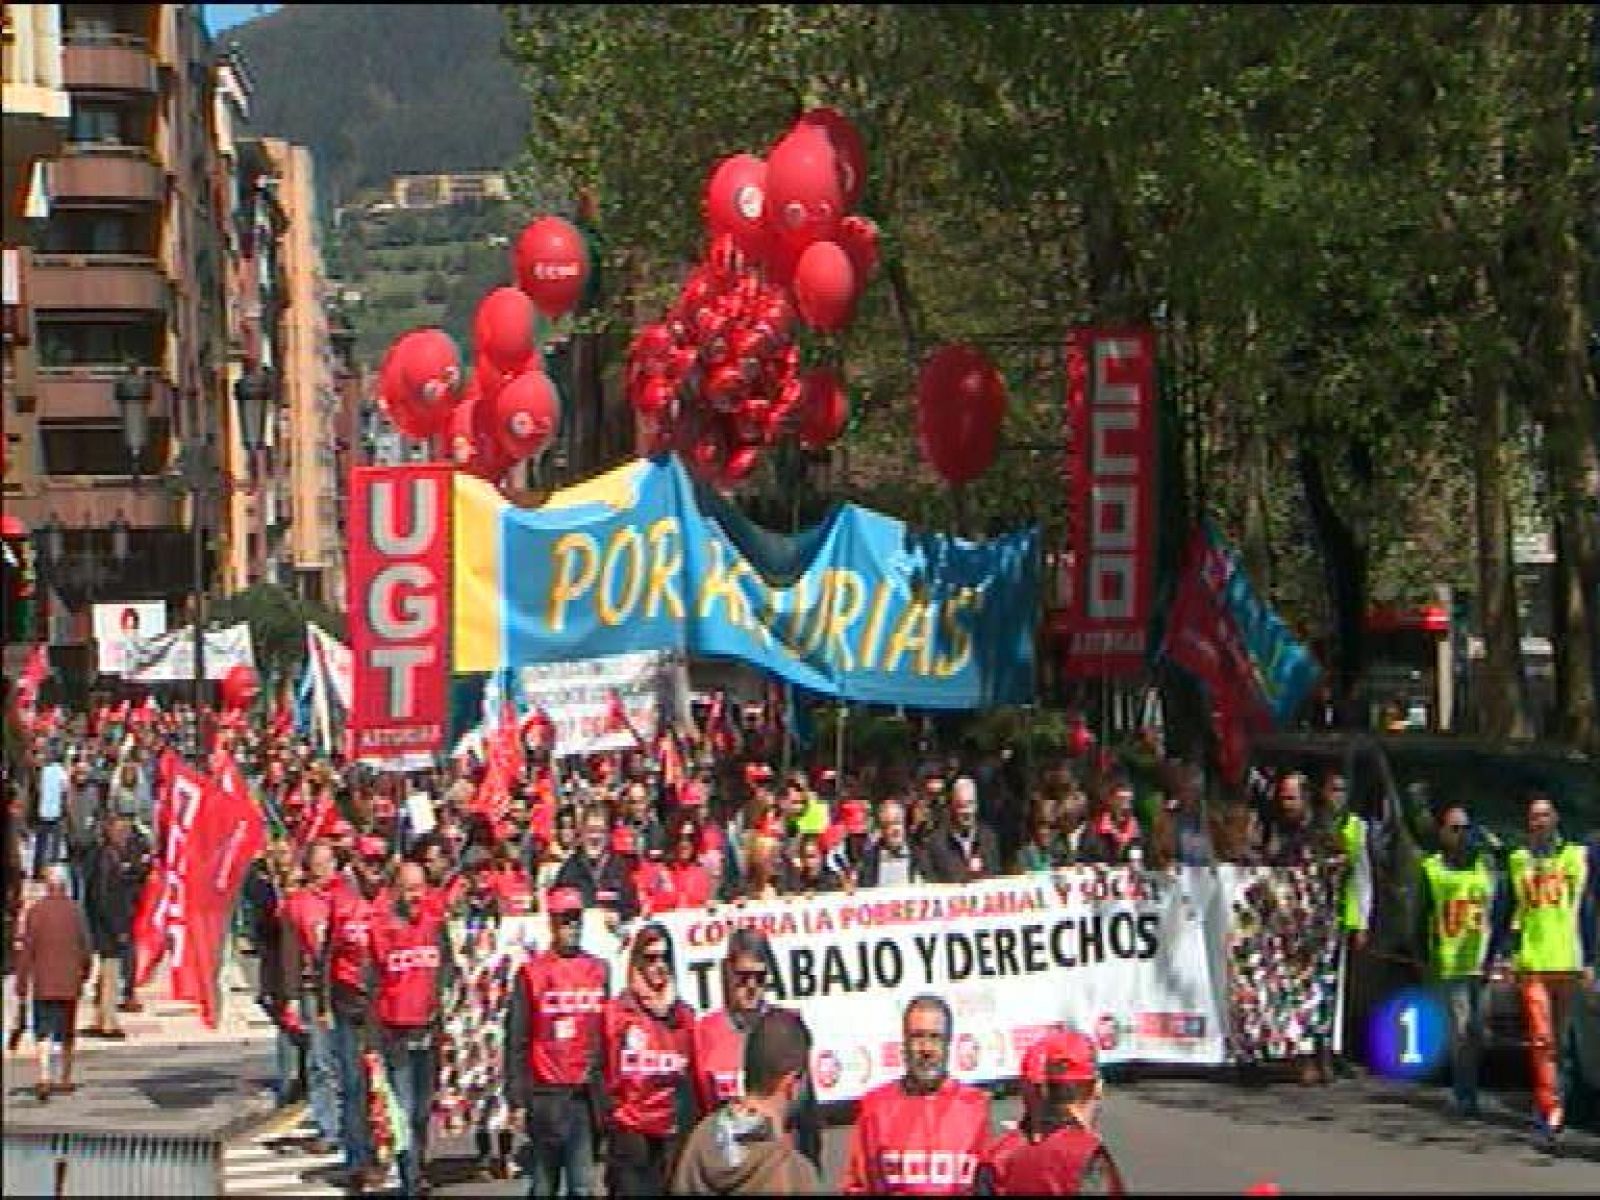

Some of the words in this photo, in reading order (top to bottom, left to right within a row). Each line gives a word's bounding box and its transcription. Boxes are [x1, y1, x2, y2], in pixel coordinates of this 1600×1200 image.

[1093, 339, 1141, 618] CCOO
[371, 478, 438, 717] UGT
[547, 518, 685, 631] POR
[802, 905, 836, 936] LA
[838, 898, 942, 931] POBREZA
[947, 886, 1046, 922] SALARIAL
[1053, 878, 1076, 906] Y
[686, 938, 905, 1010] TABAJO
[912, 932, 938, 984] Y
[945, 912, 1160, 980] DERECHOS
[881, 1150, 977, 1184] CCOO
